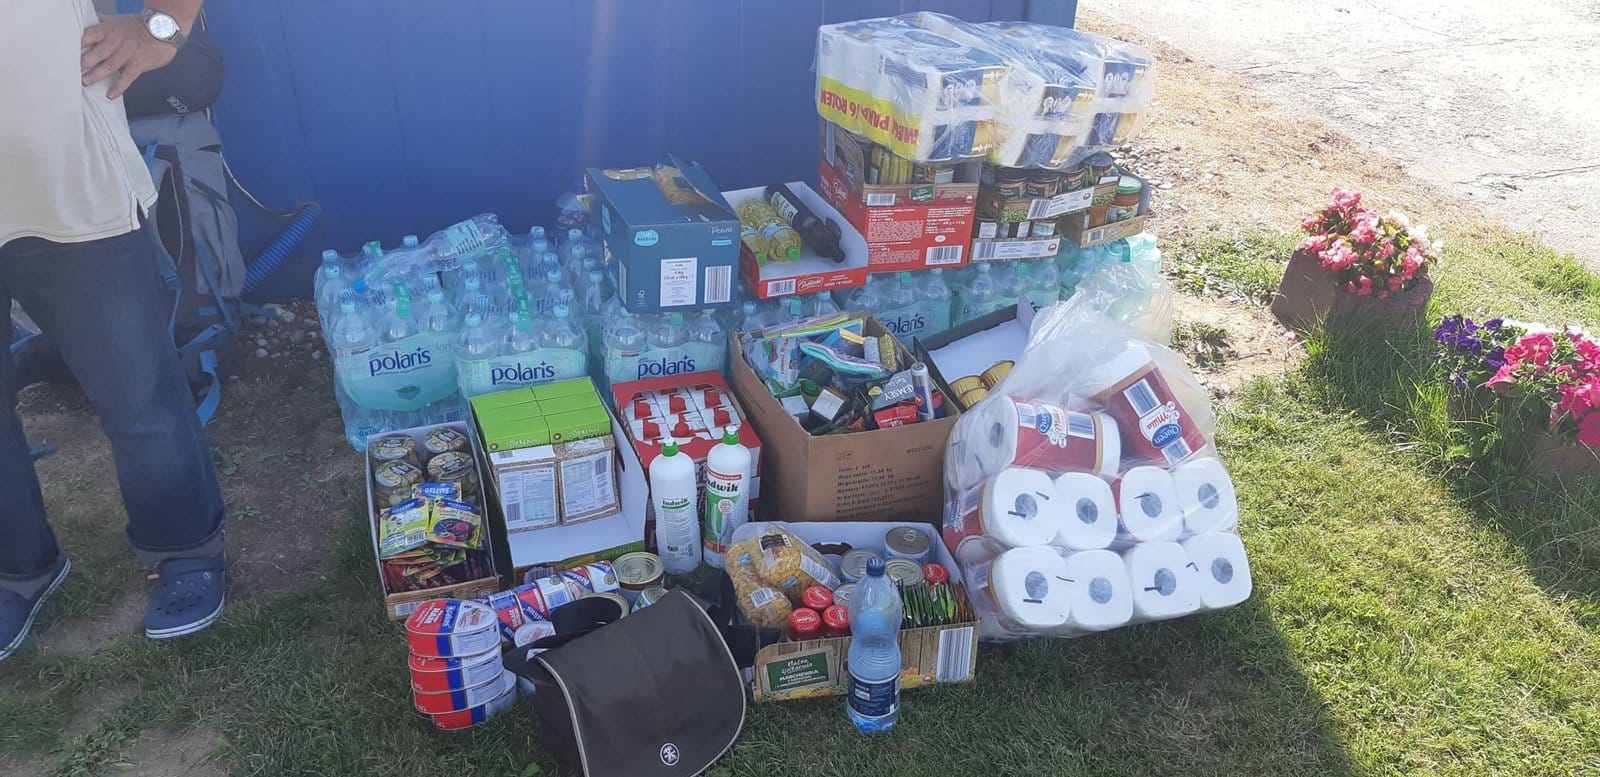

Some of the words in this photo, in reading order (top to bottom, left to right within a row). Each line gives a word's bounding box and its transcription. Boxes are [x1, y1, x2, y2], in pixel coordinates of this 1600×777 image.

[885, 313, 925, 335] olaris
[369, 346, 431, 377] polaris
[637, 354, 696, 380] polaris
[491, 361, 555, 386] polaris
[1146, 413, 1170, 430] Milla
[1154, 425, 1180, 444] Queen
